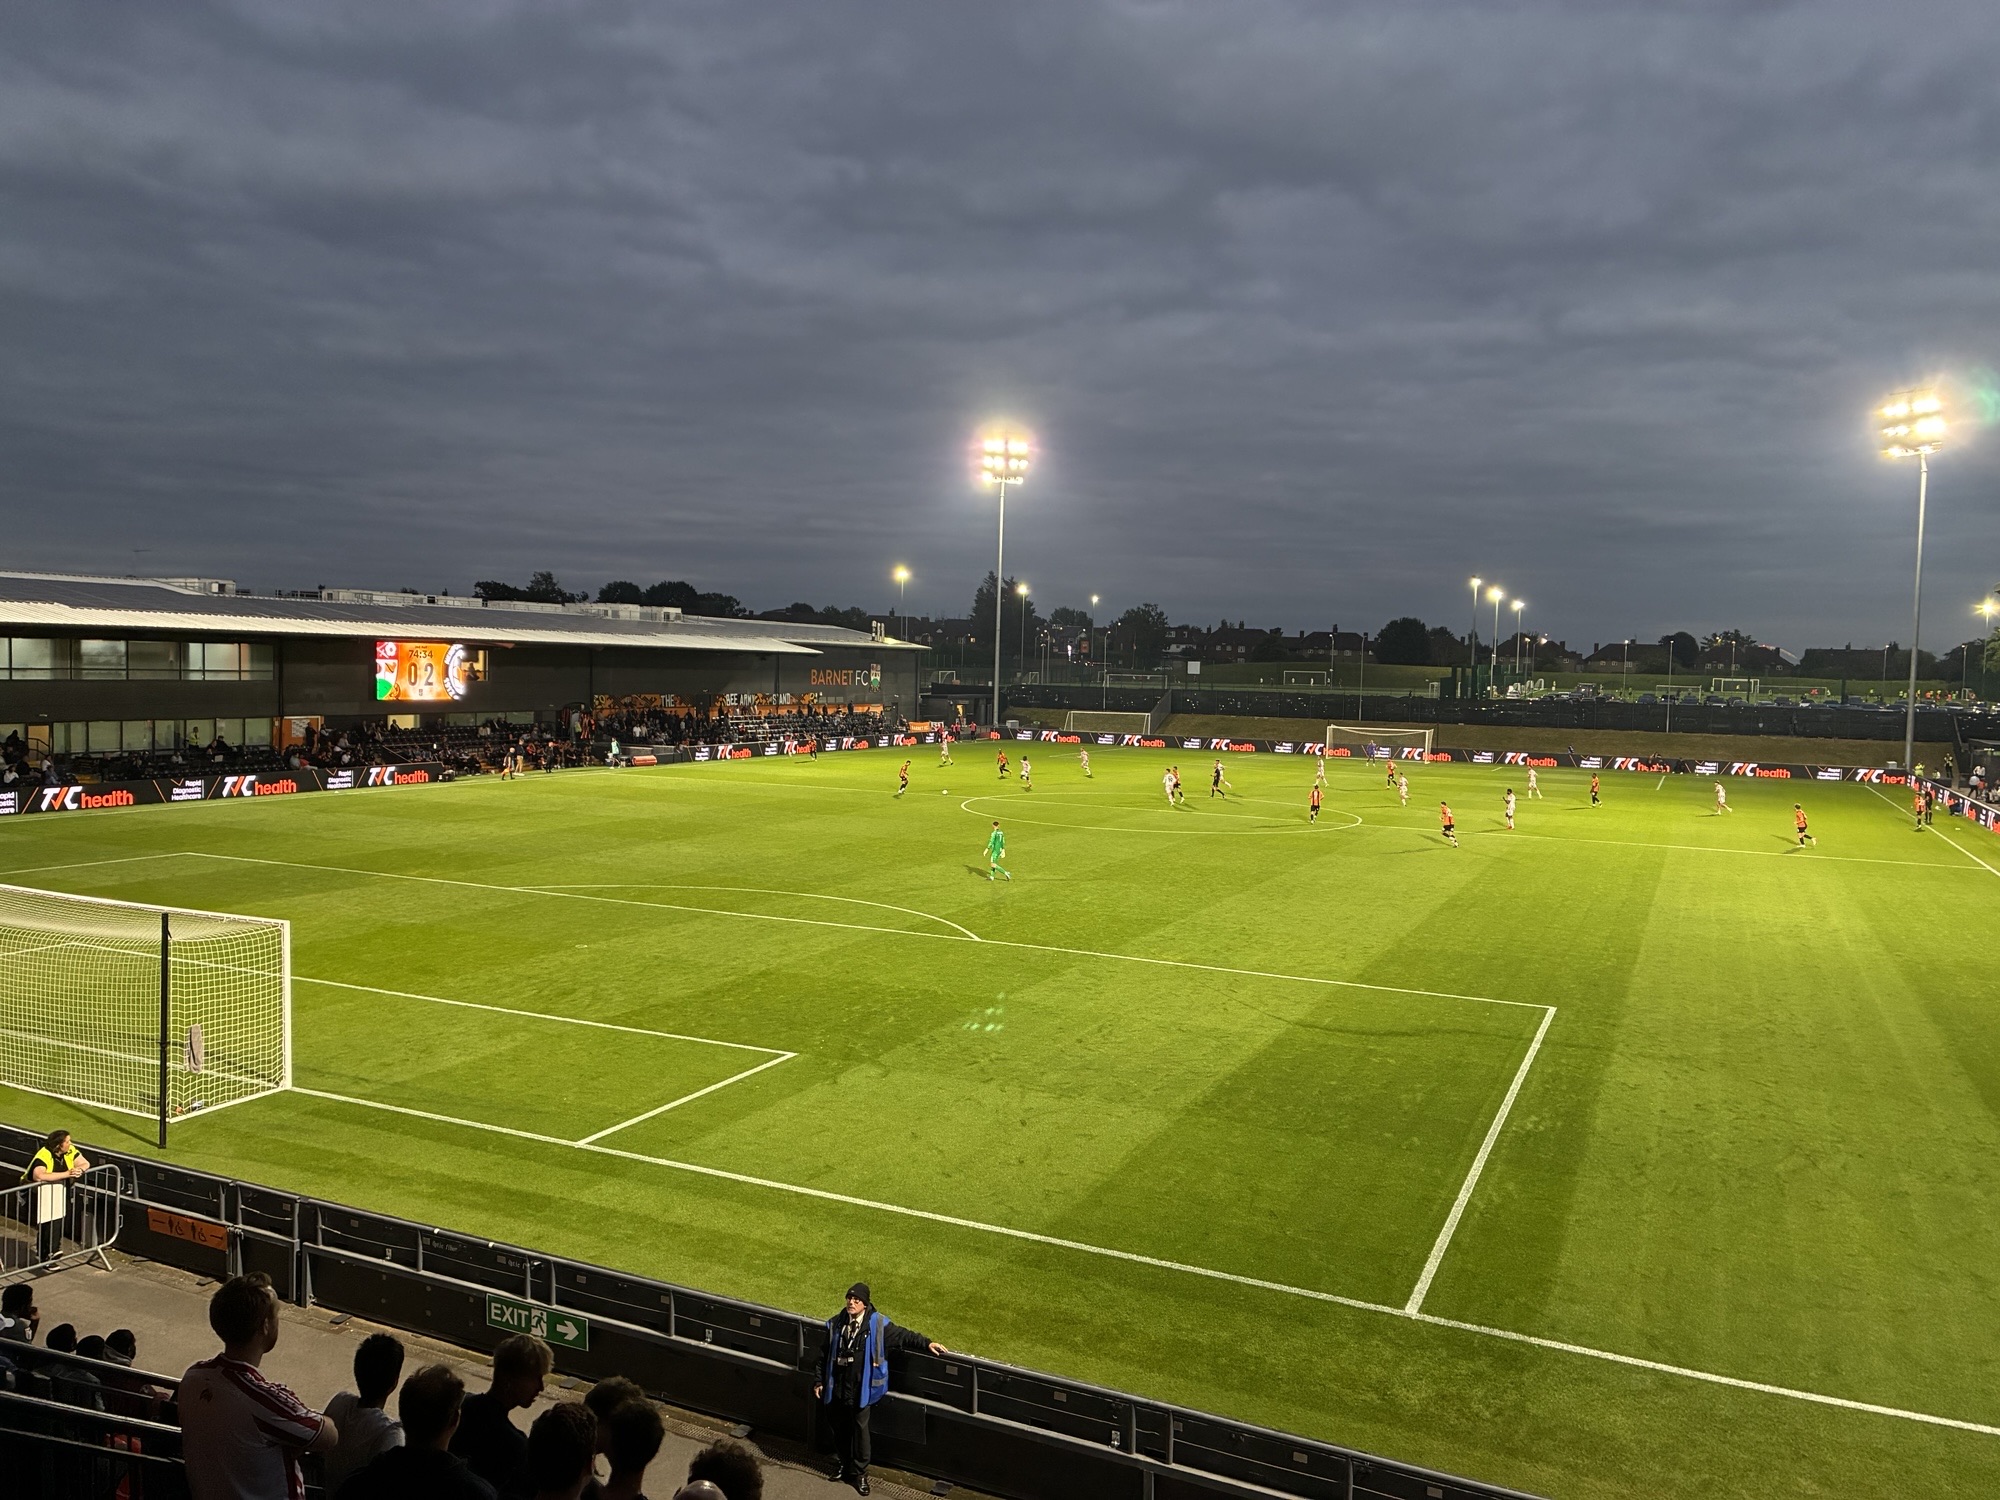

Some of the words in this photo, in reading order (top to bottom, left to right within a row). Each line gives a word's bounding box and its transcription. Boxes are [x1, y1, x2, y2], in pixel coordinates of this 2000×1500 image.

[409, 650, 433, 658] 74:34
[408, 662, 418, 686] 0
[424, 662, 434, 686] 2
[811, 669, 853, 686] BARNET
[855, 670, 869, 686] FC
[661, 694, 675, 708] THE
[726, 694, 738, 706] BEE
[1057, 735, 1080, 744] health
[1141, 738, 1165, 748] health
[732, 748, 751, 758] health
[1229, 743, 1255, 752] health
[1323, 747, 1350, 756] health
[1527, 757, 1557, 767] health
[394, 770, 429, 785] health
[1756, 768, 1790, 778] health
[255, 779, 296, 795] health
[81, 790, 134, 808] health
[491, 1302, 529, 1327] EXIT
